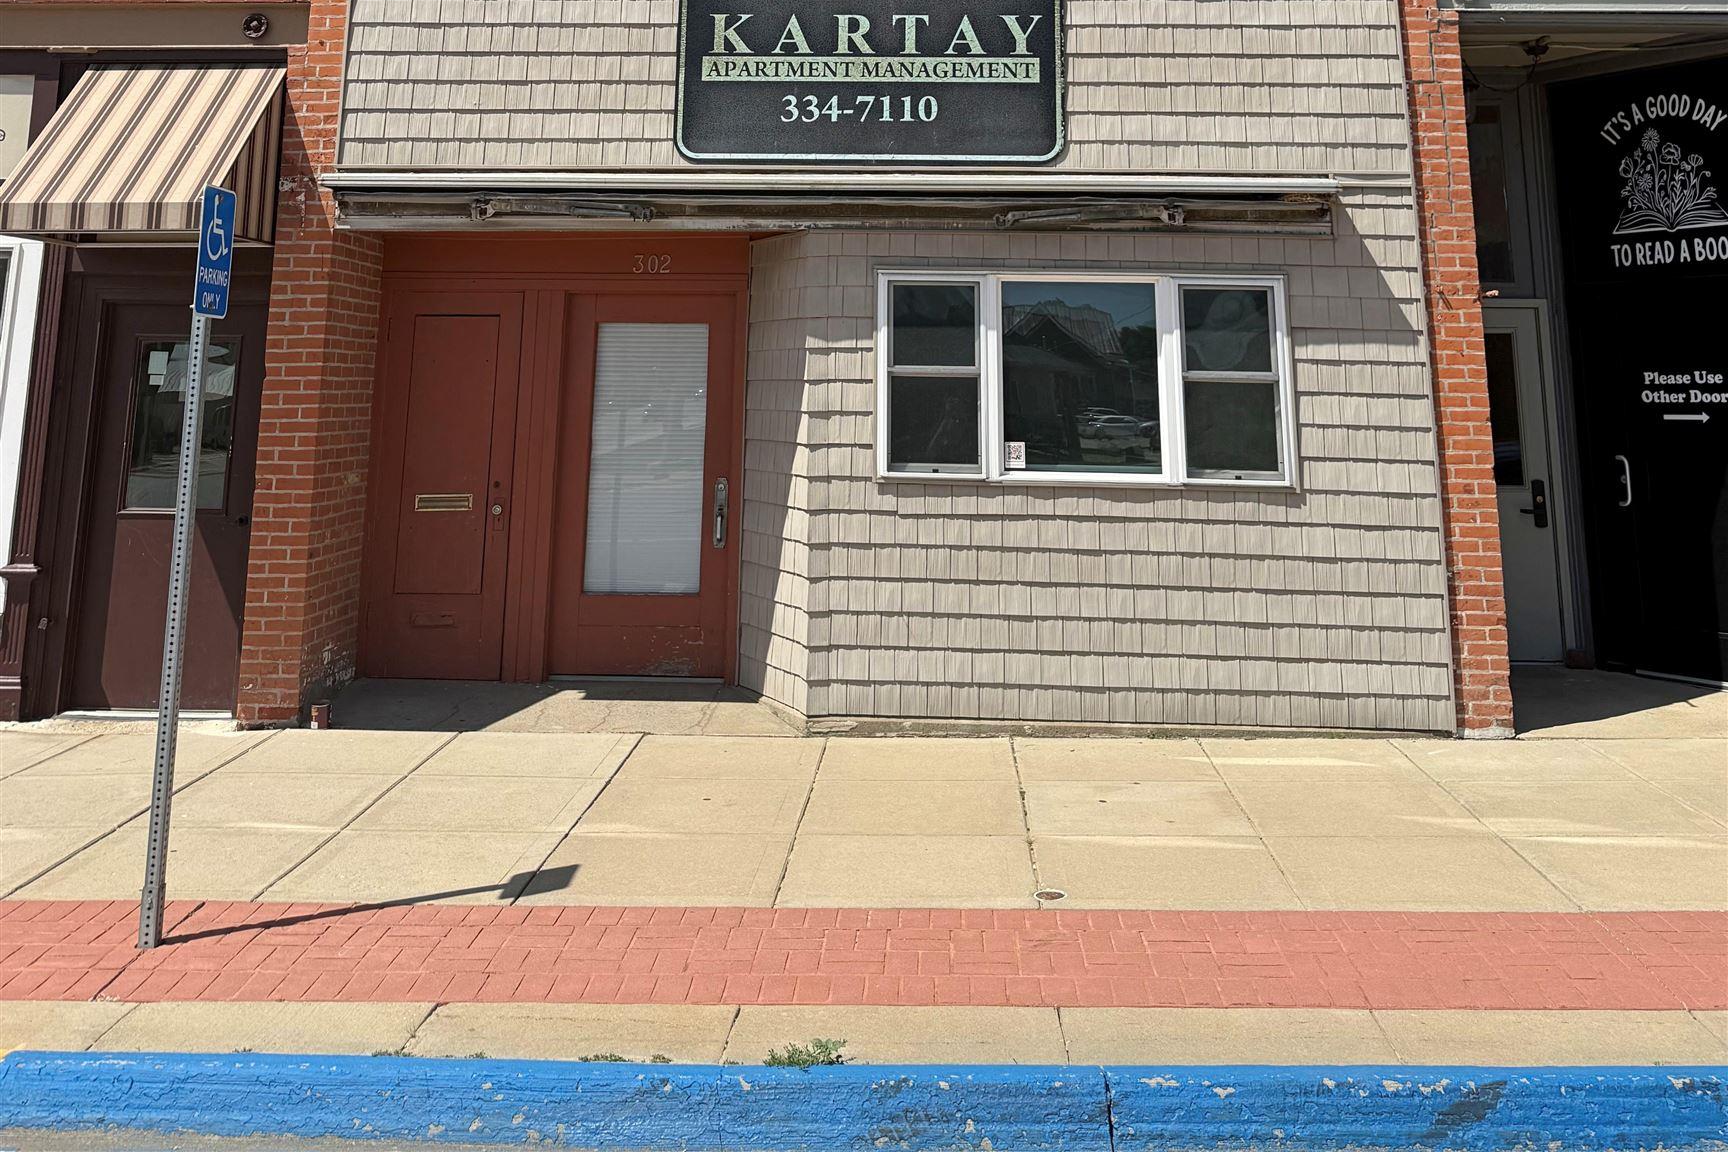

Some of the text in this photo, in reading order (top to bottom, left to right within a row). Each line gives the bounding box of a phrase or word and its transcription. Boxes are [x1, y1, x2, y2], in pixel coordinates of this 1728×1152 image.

[708, 13, 1043, 55] KARTAY
[706, 60, 1036, 80] APARTMENT MANAGEMENT
[780, 94, 939, 123] 334-7110
[1600, 94, 1728, 145] IT'S A GOOD DAY
[1610, 244, 1632, 267] TO
[1635, 240, 1675, 265] READ
[1680, 239, 1691, 263] A
[632, 254, 672, 274] 302
[199, 266, 228, 287] PARKING
[1643, 370, 1723, 384] Please Use
[1641, 389, 1728, 403] Other Door
